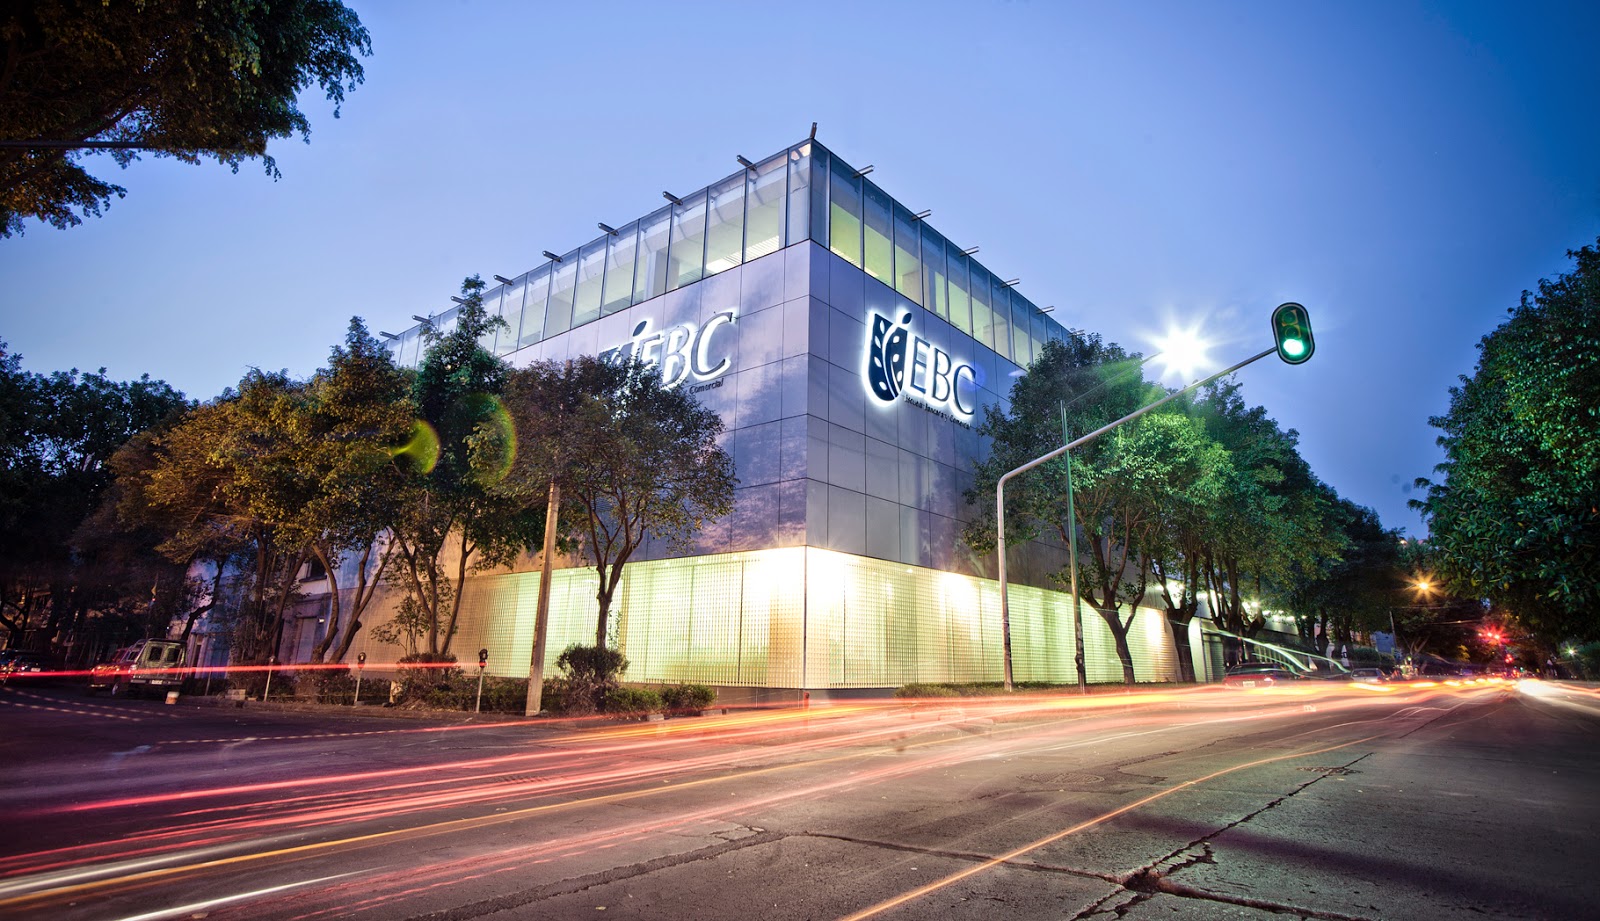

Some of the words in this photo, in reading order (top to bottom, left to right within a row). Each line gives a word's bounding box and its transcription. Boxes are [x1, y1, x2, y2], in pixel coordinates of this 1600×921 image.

[636, 312, 733, 385] EBC
[910, 336, 976, 416] EBC
[689, 377, 725, 394] Comercial
